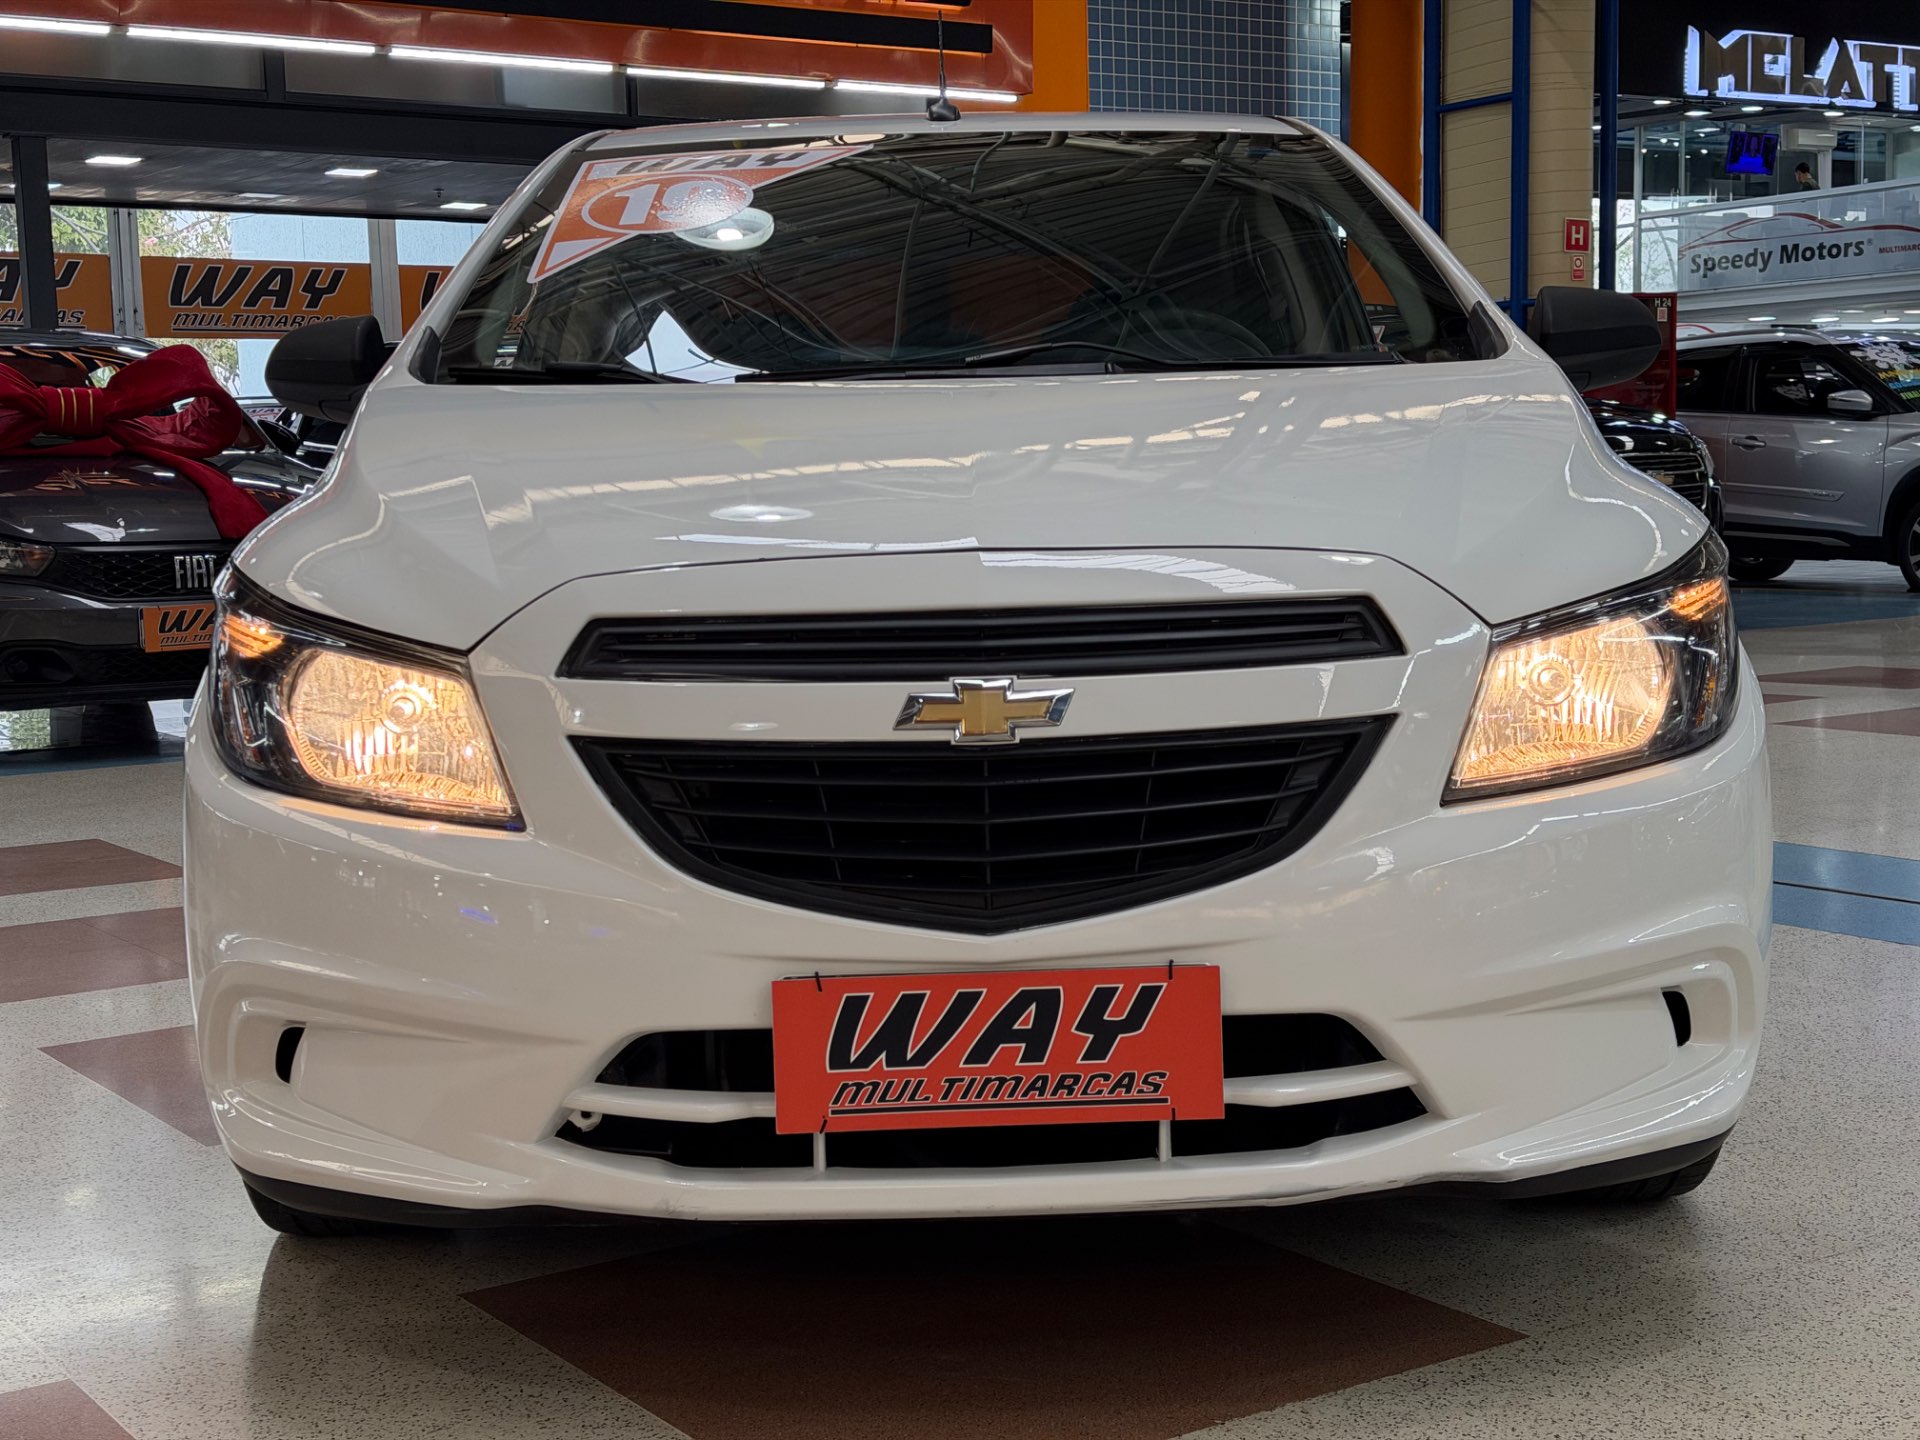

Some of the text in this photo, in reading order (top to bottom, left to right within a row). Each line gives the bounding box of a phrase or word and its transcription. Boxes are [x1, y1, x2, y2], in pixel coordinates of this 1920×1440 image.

[616, 152, 809, 175] WAY
[1690, 248, 1773, 279] Speedy
[169, 264, 348, 310] WAY
[174, 554, 217, 589] FIAT
[826, 983, 1168, 1073] WAY
[830, 1070, 1170, 1107] MULTIMARCAS
